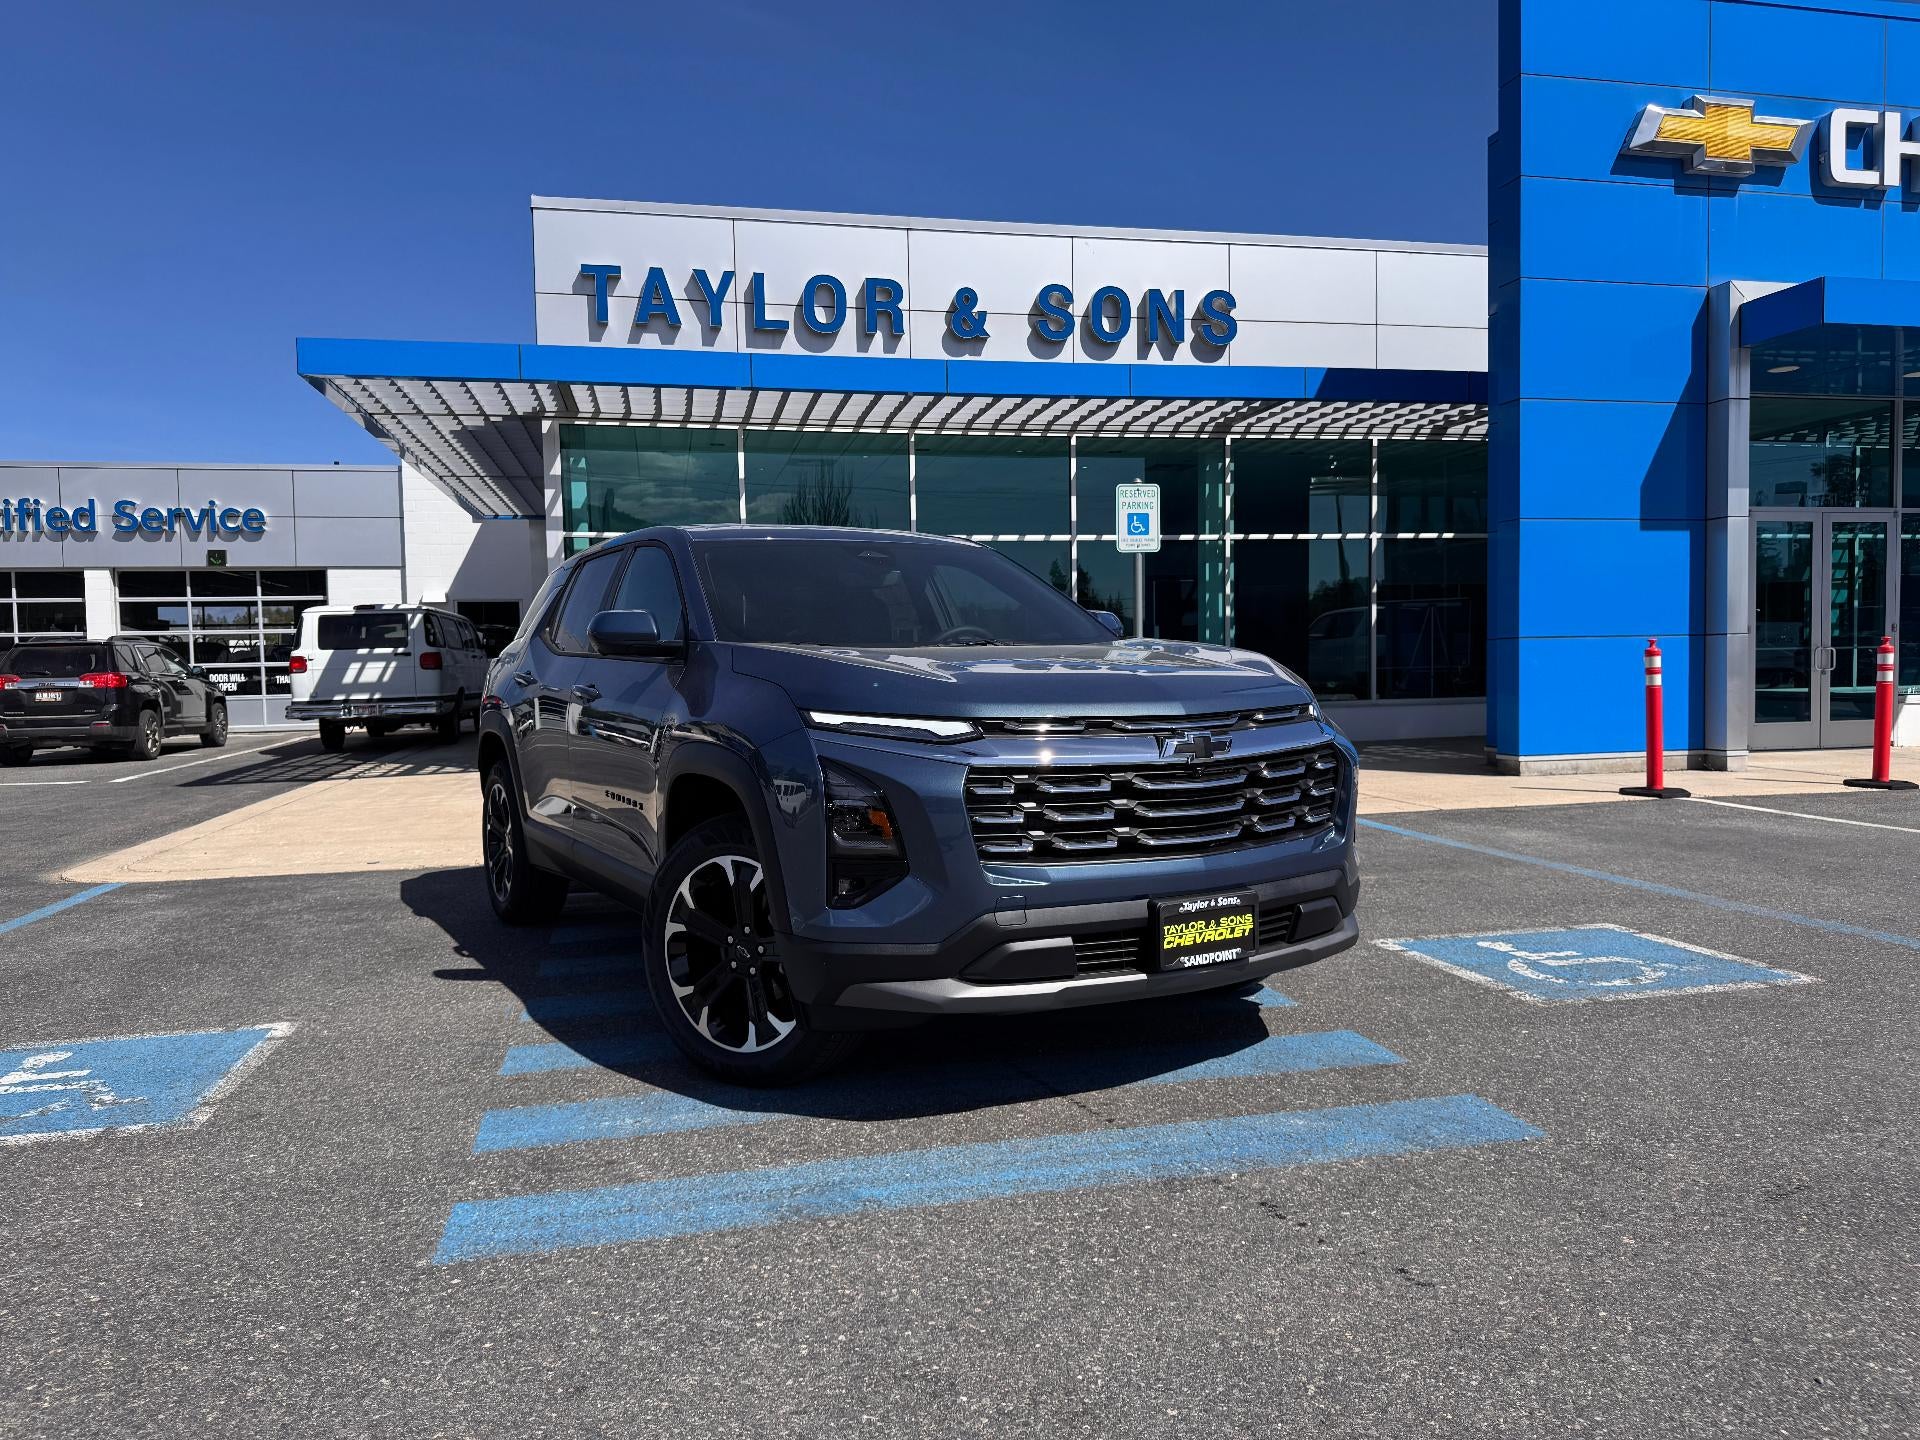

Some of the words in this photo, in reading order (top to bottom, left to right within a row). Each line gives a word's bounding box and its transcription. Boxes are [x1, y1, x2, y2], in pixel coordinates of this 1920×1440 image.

[580, 262, 905, 336] TAYLOR
[950, 286, 991, 341] &
[1036, 283, 1239, 347] SONS
[1119, 489, 1156, 498] RESERVED
[112, 499, 267, 532] Service
[1121, 501, 1154, 510] PARKING
[1182, 901, 1209, 913] Taylor
[1163, 920, 1206, 936] TAYLOR
[1208, 919, 1217, 930] &
[1219, 913, 1253, 928] SONS
[1163, 924, 1254, 949] CHEVROLET
